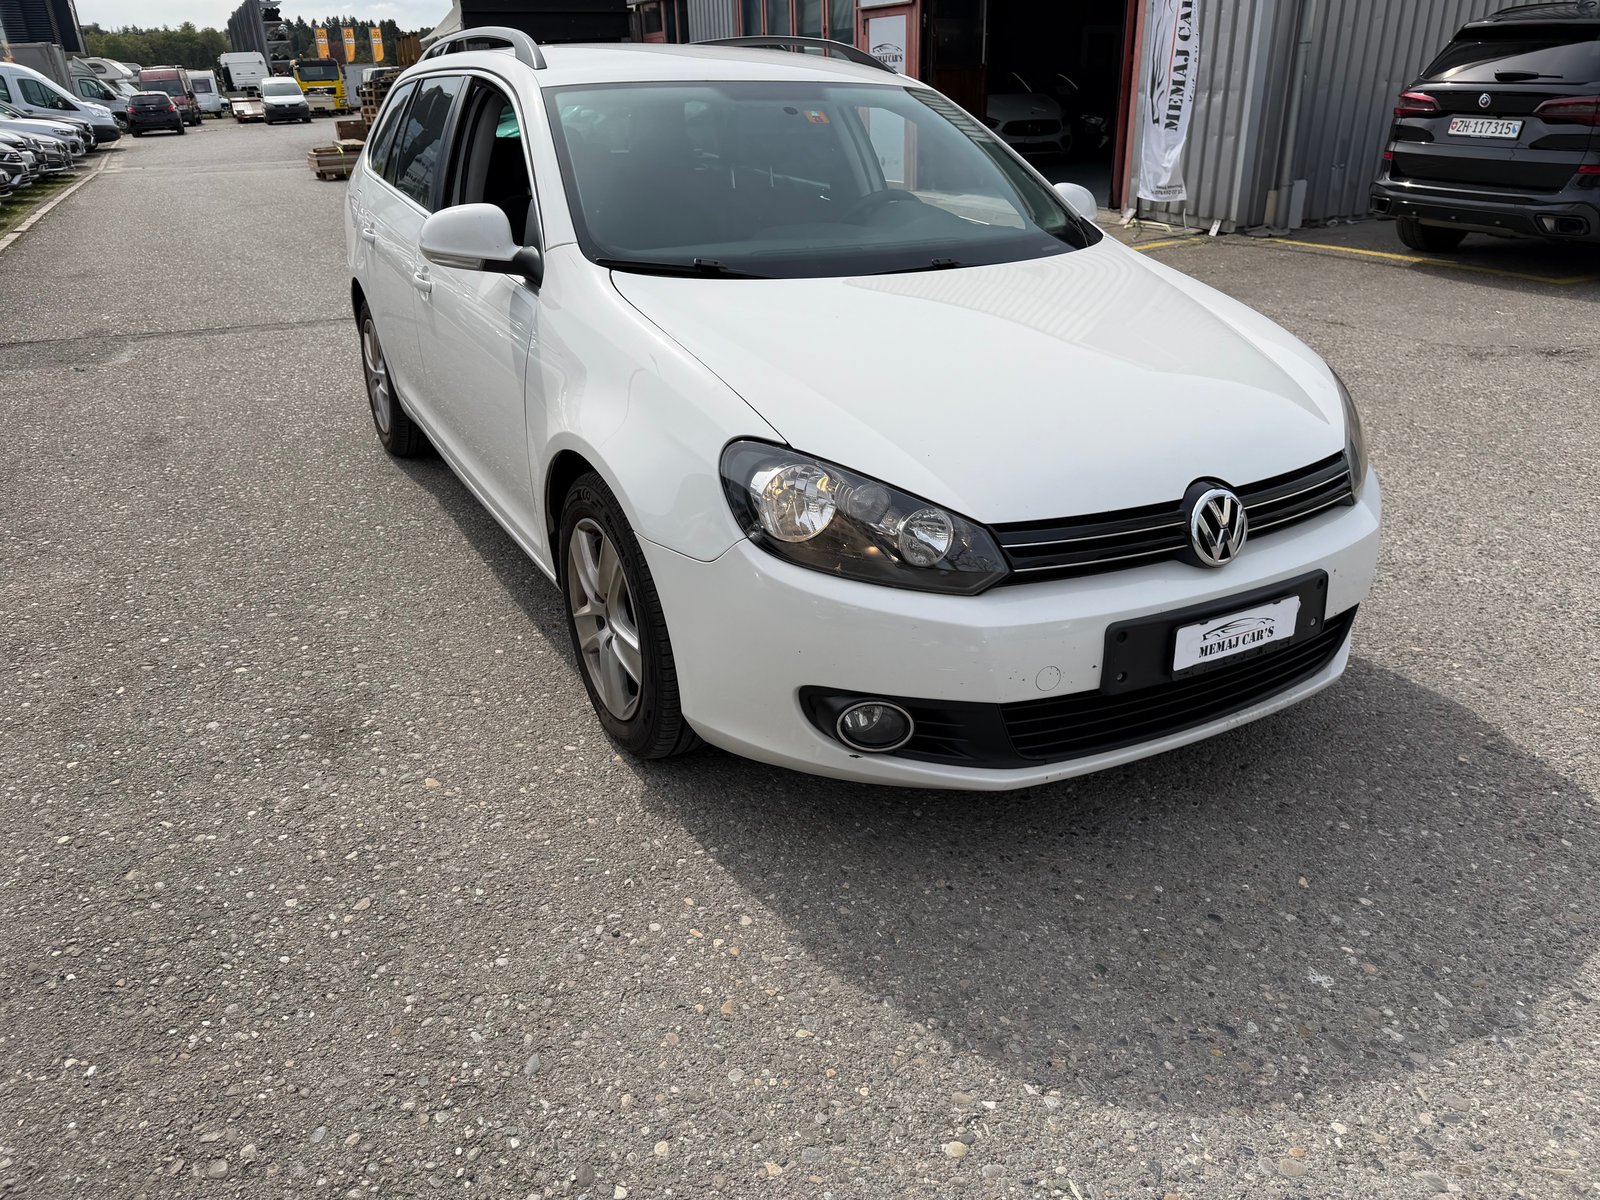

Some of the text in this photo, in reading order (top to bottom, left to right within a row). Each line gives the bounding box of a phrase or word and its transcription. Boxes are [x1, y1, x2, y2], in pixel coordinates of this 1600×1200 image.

[1164, 48, 1190, 132] MEMAJ
[1199, 625, 1275, 658] MEMAJ CAR'S
